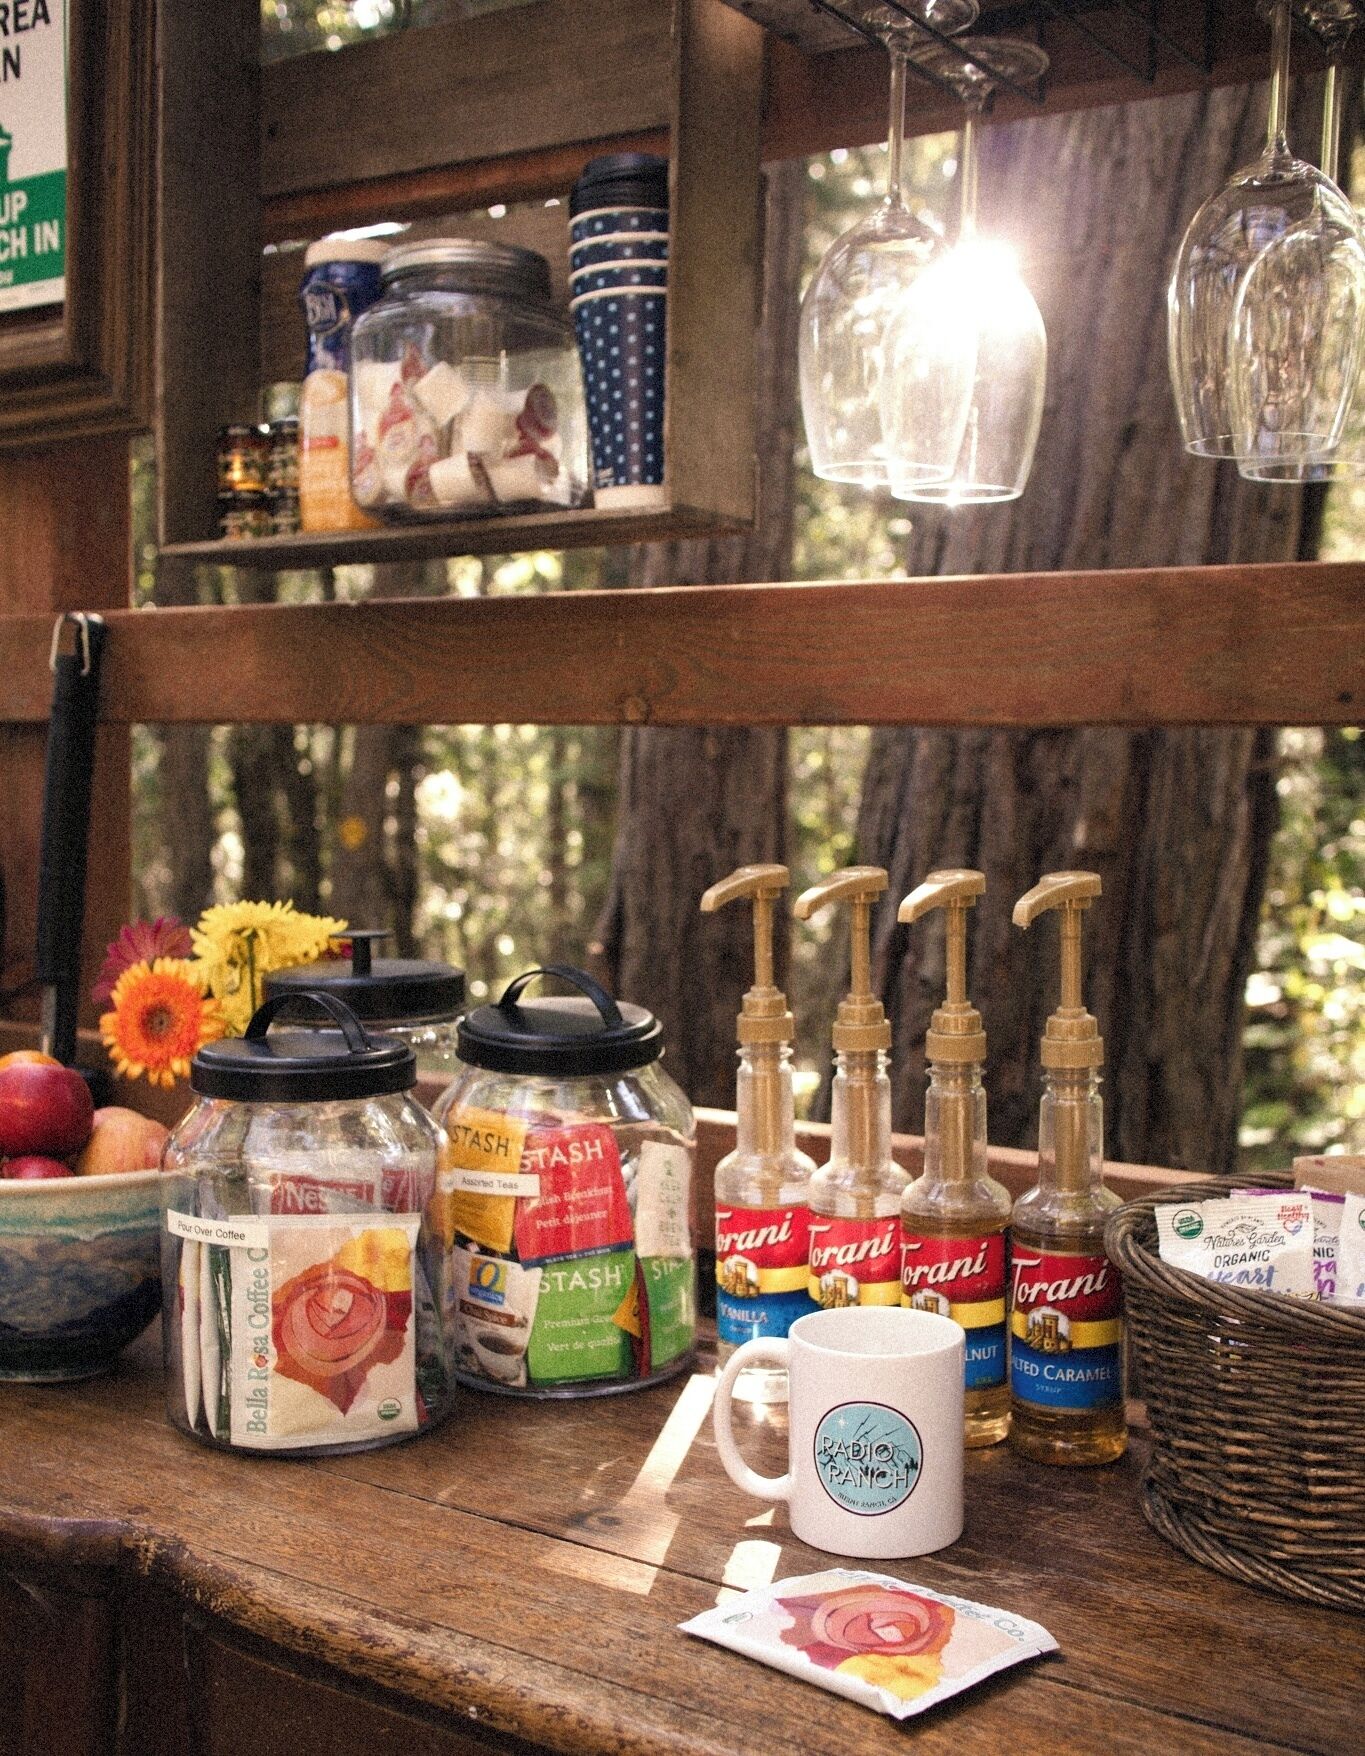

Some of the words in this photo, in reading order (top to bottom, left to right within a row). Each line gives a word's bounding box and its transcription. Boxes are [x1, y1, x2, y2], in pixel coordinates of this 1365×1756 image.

[34, 219, 59, 256] IN
[451, 1125, 509, 1157] STASH
[520, 1139, 604, 1171] STASH
[462, 1177, 494, 1188] Assorted
[497, 1180, 518, 1190] Teas
[178, 1221, 192, 1233] Pour
[194, 1225, 212, 1237] Over
[215, 1228, 246, 1241] Coffee
[807, 1223, 896, 1267] Torani
[1248, 1231, 1286, 1250] Garden
[900, 1242, 987, 1291] Torani
[1214, 1250, 1270, 1268] ORGANIC
[539, 1264, 621, 1293] STASH
[1011, 1257, 1110, 1311] Torani
[246, 1267, 269, 1329] Coffee
[720, 1302, 767, 1324] VANILLA
[247, 1387, 268, 1433] Bella
[823, 1435, 895, 1462] RADIO
[829, 1464, 909, 1489] RANCH
[993, 1617, 1025, 1642] Co.
